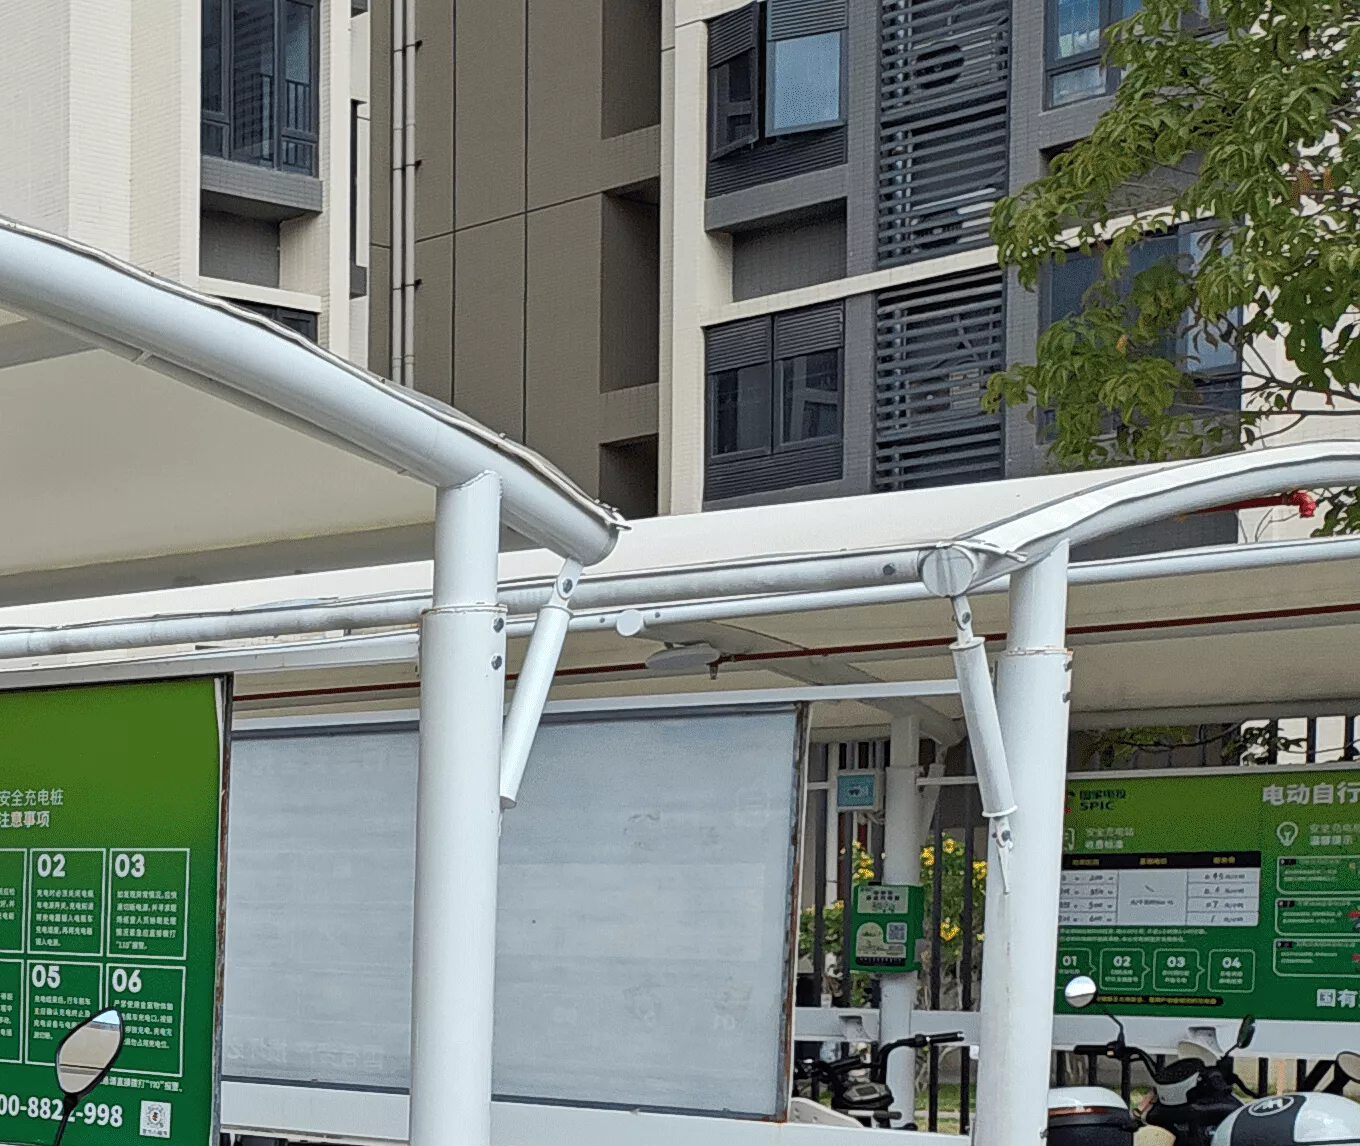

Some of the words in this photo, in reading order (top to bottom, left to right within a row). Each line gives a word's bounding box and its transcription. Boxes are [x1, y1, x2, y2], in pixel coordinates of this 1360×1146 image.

[1262, 781, 1360, 806] 电动自行
[1080, 801, 1116, 811] SPIC
[37, 853, 66, 878] 02
[114, 853, 146, 878] 03
[1061, 955, 1078, 967] 01
[1113, 955, 1133, 968] 02
[1166, 956, 1186, 968] 03
[1221, 957, 1242, 969] 04
[31, 965, 61, 989] 05
[111, 968, 143, 993] 06
